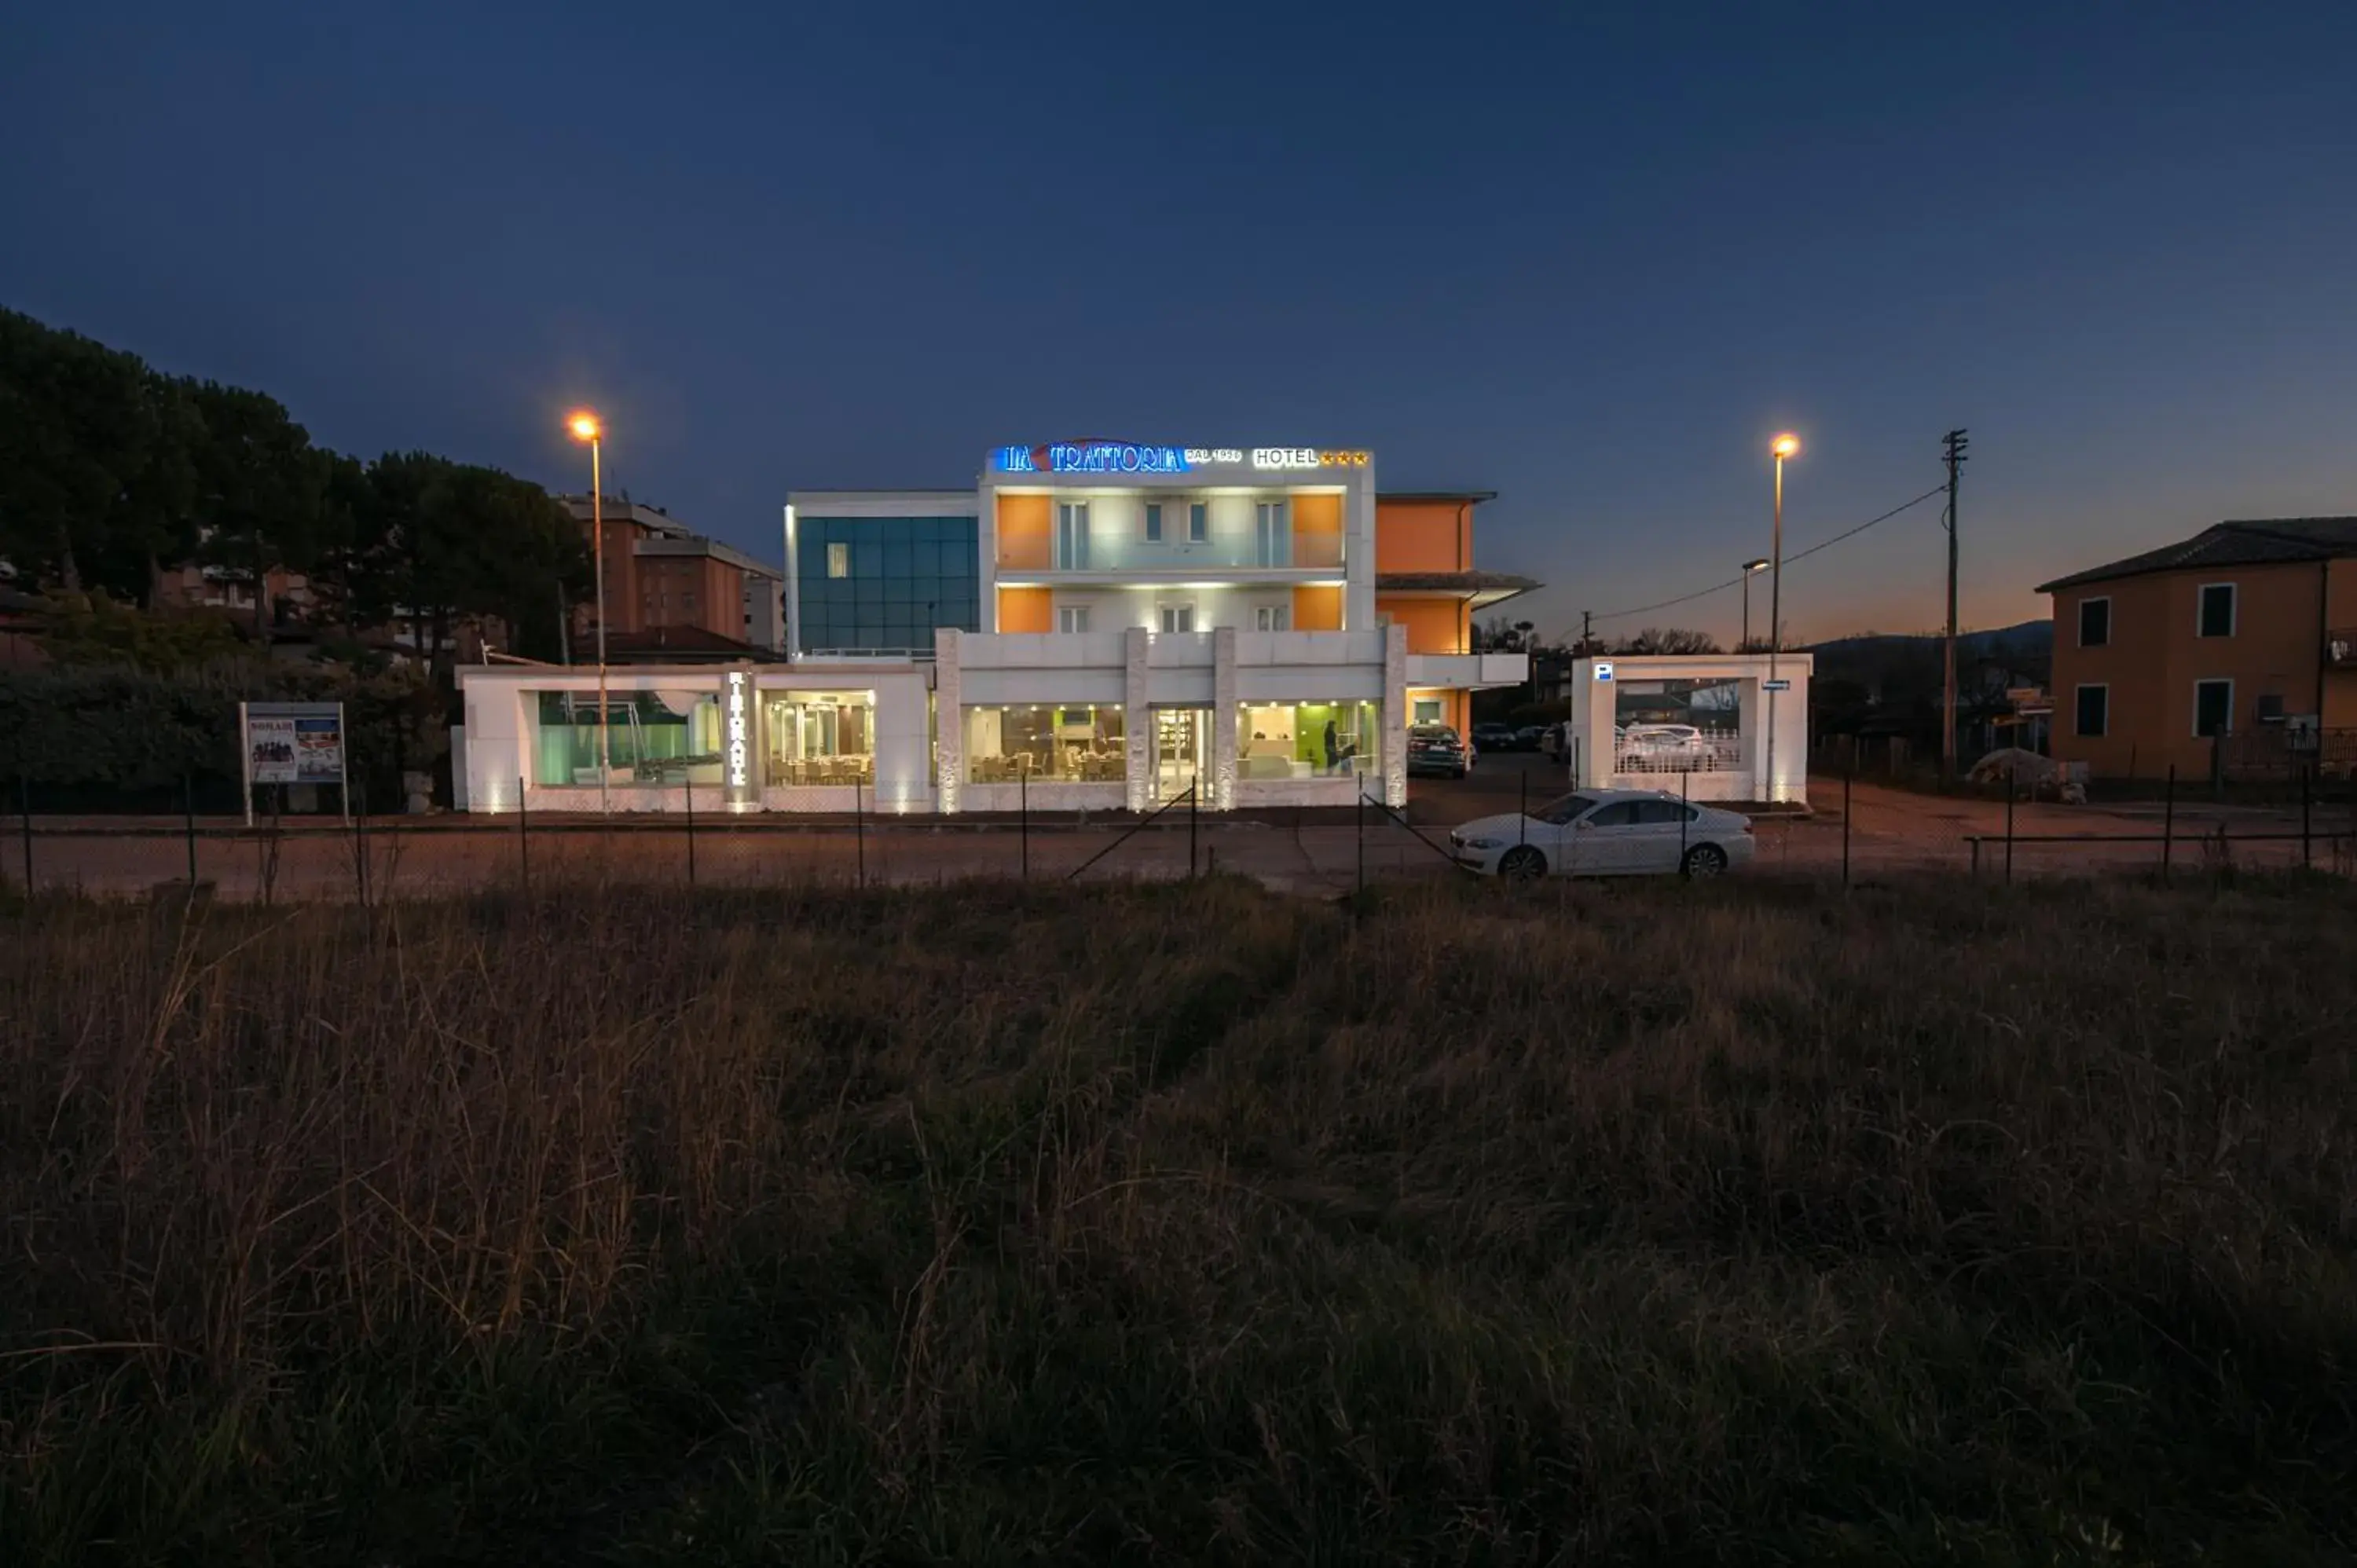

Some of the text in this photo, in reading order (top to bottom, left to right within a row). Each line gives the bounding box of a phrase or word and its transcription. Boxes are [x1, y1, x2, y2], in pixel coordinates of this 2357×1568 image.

[1006, 445, 1182, 471] LA TRATTORIA
[1254, 449, 1318, 467] HOTEL
[729, 672, 746, 786] RISTORANTE
